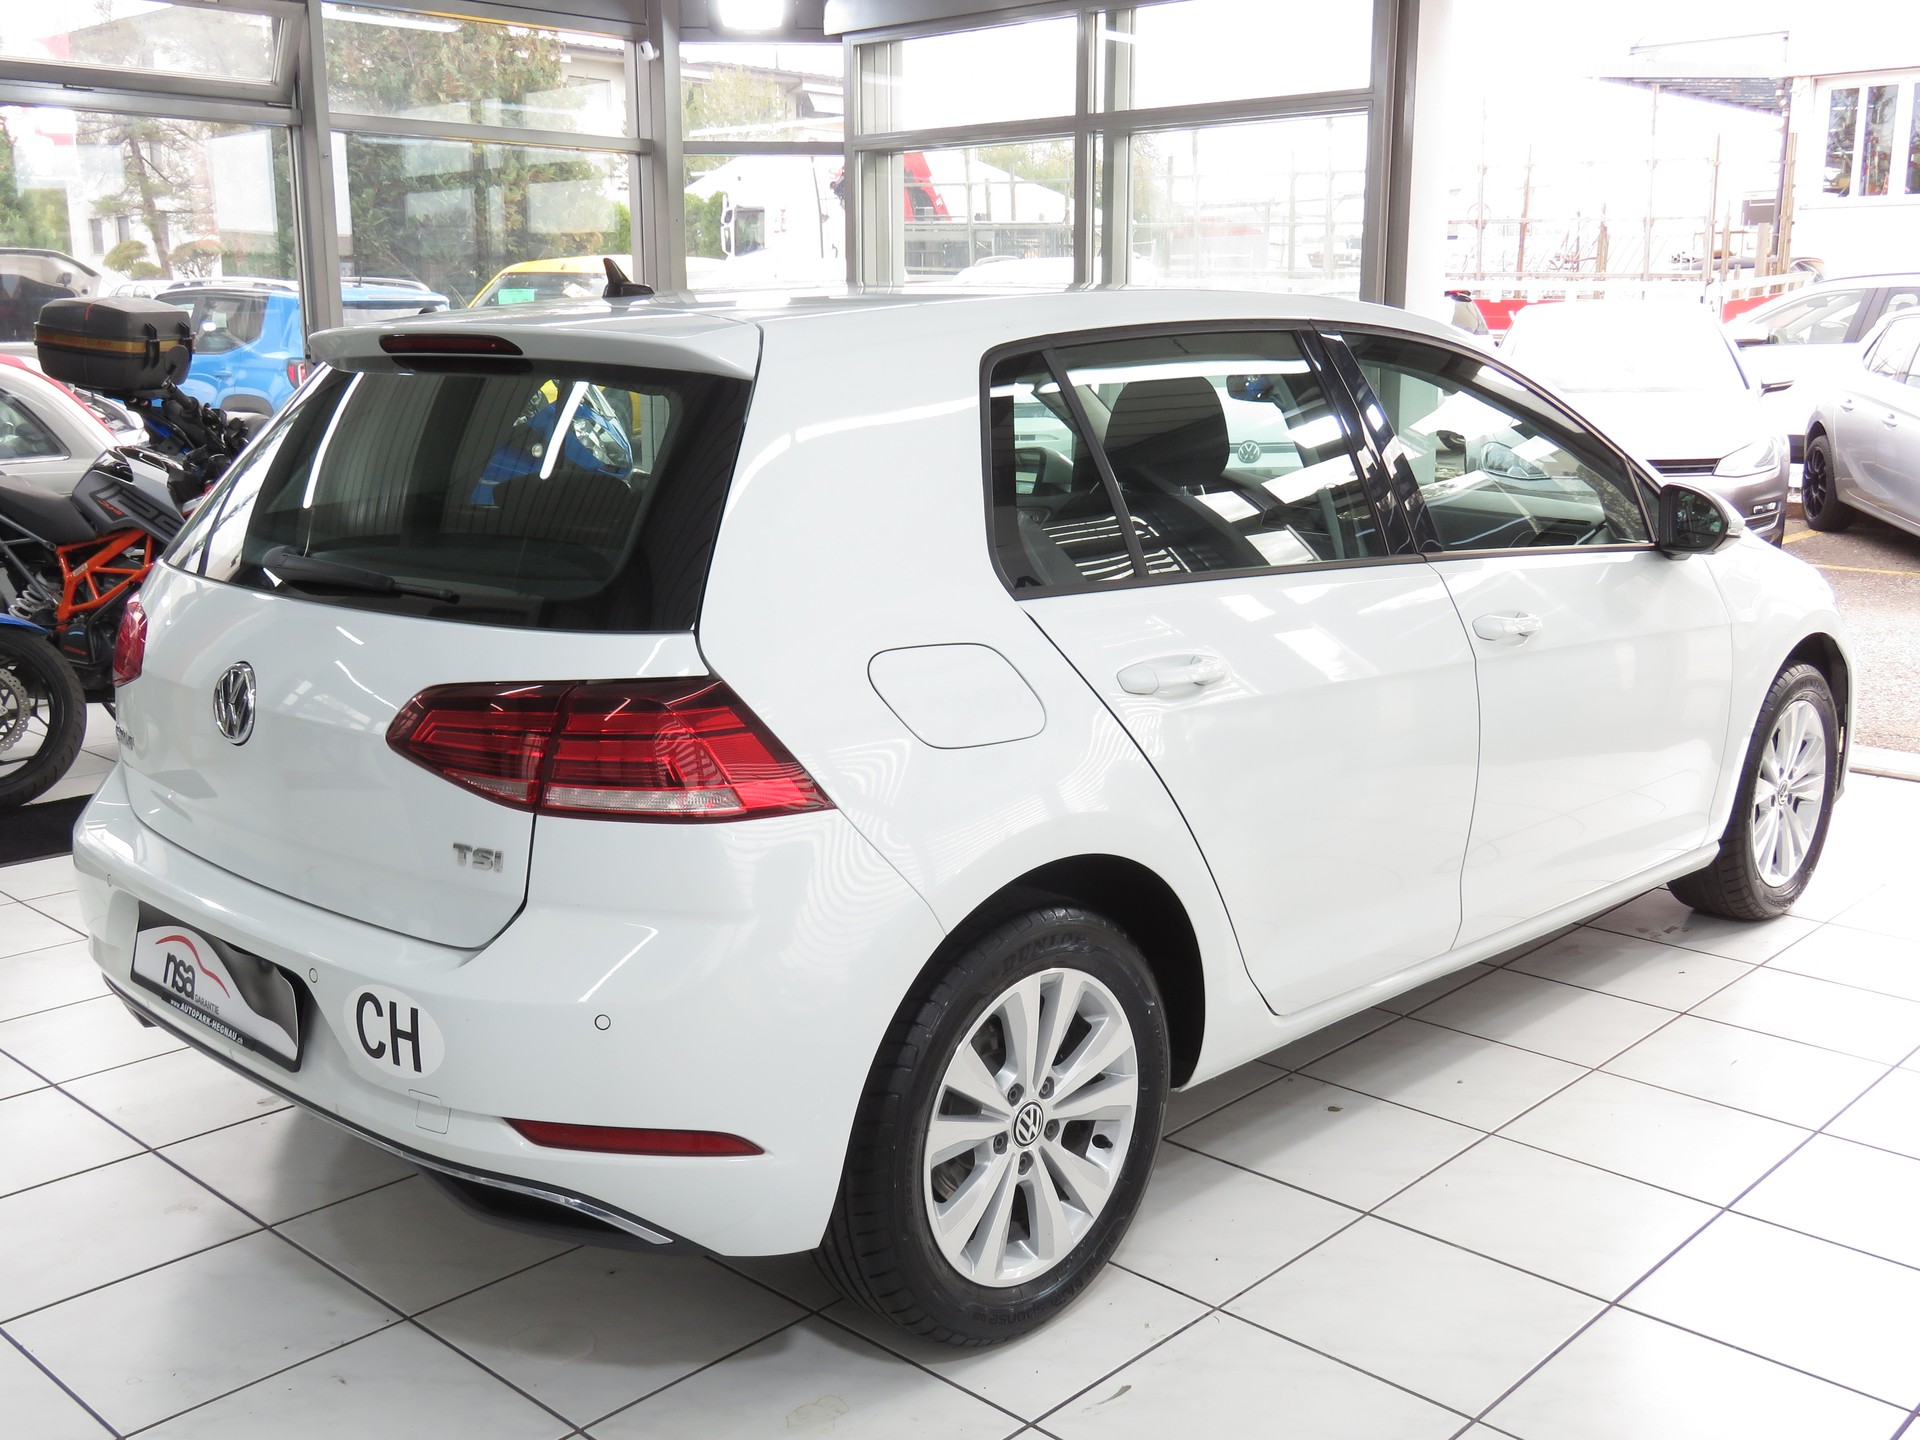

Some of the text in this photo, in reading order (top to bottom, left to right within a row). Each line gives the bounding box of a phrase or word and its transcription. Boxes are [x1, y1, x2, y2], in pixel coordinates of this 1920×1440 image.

[453, 842, 504, 873] TSI
[163, 952, 196, 1000] nsa
[170, 1000, 244, 1045] www.AUTOPARK-HEGNAU.ch
[194, 994, 220, 1015] GARANTIE
[356, 991, 422, 1073] CH
